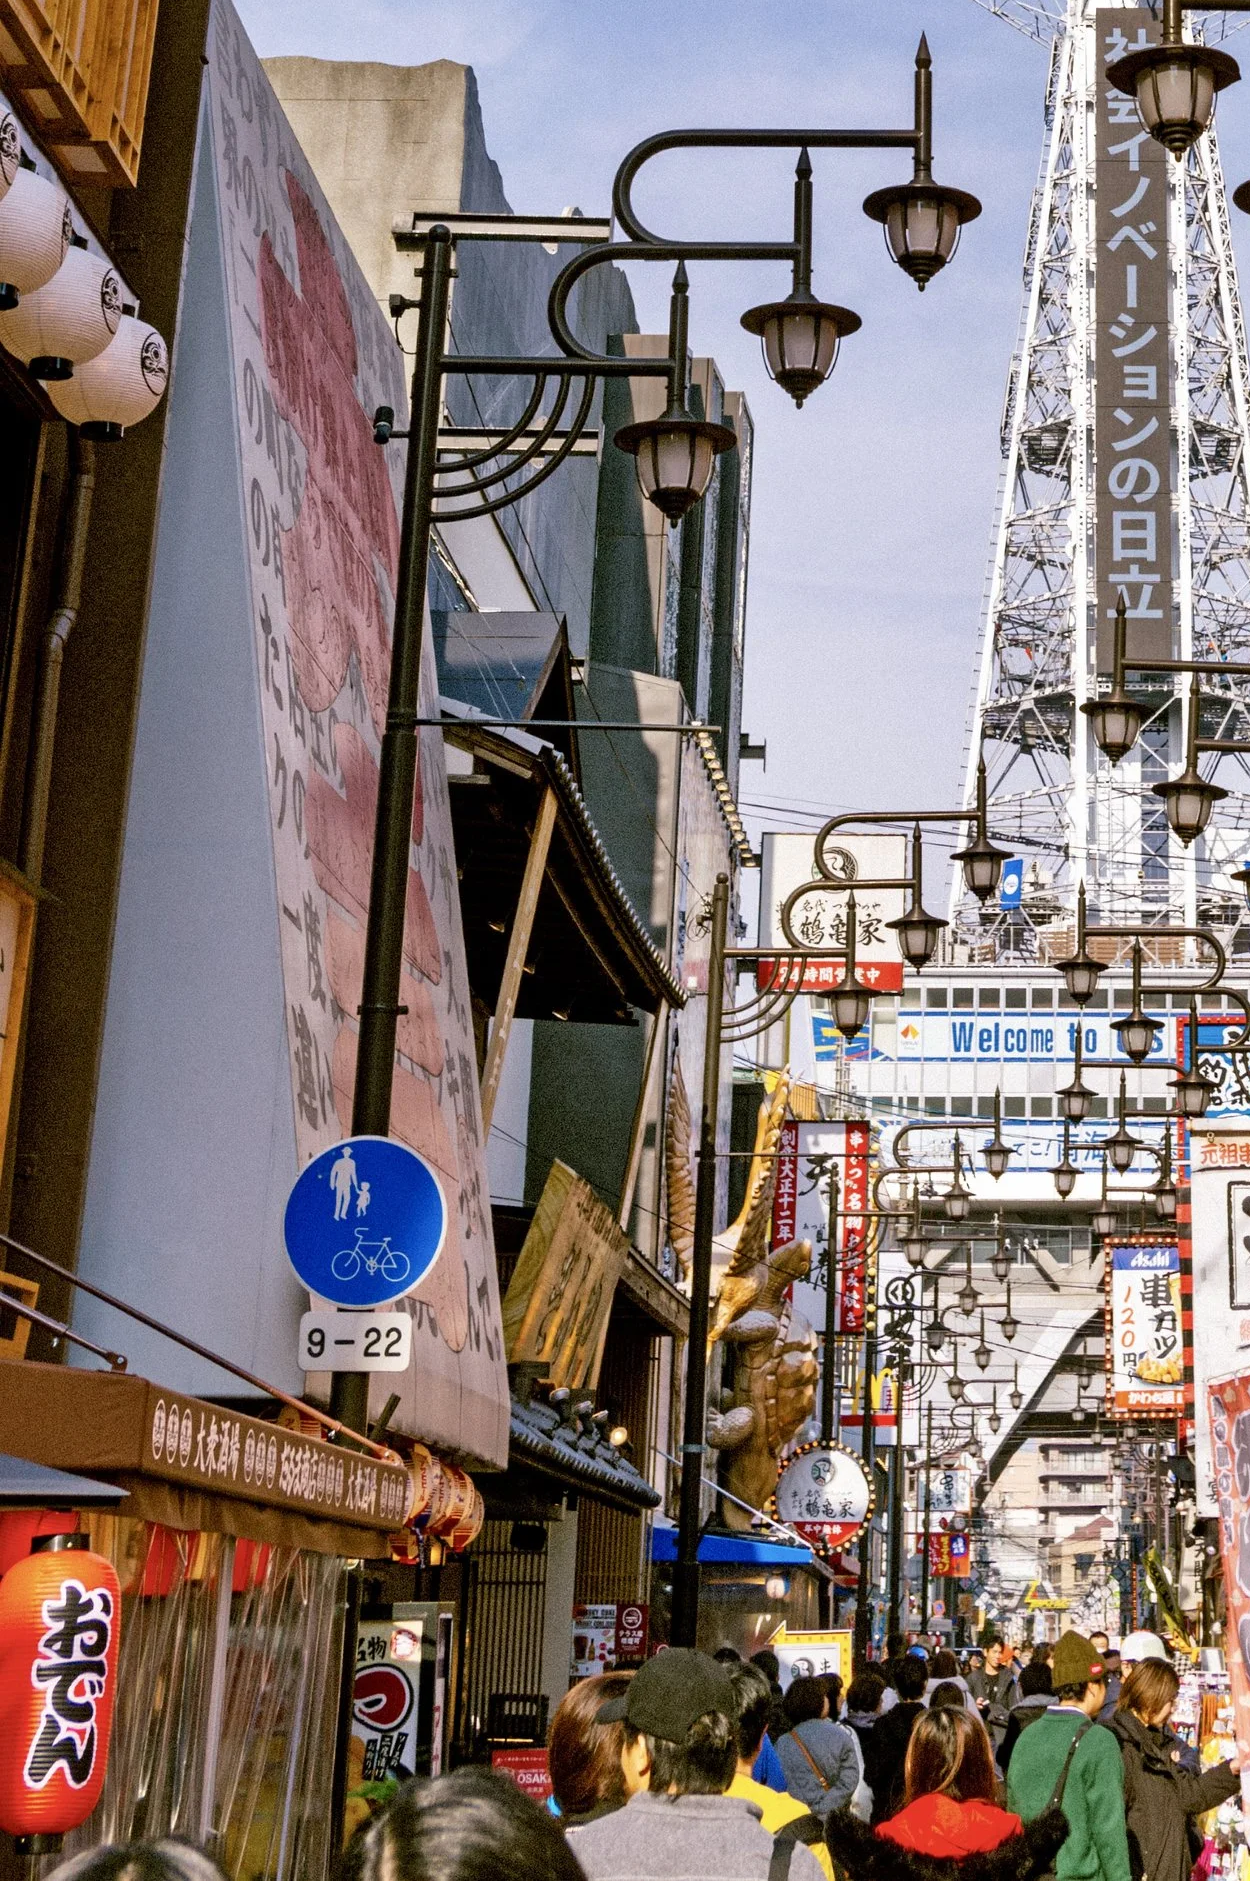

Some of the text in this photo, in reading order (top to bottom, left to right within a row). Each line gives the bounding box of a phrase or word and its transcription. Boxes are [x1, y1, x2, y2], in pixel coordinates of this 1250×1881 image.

[951, 1021, 1054, 1053] Welcome
[1067, 1021, 1098, 1053] to
[776, 1129, 797, 1241] 創業大正十二年
[1130, 1250, 1170, 1268] Asahi
[1139, 1273, 1178, 1360] 串カツ
[194, 1412, 241, 1481] 大衆酒場
[28, 1585, 113, 1785] おでん
